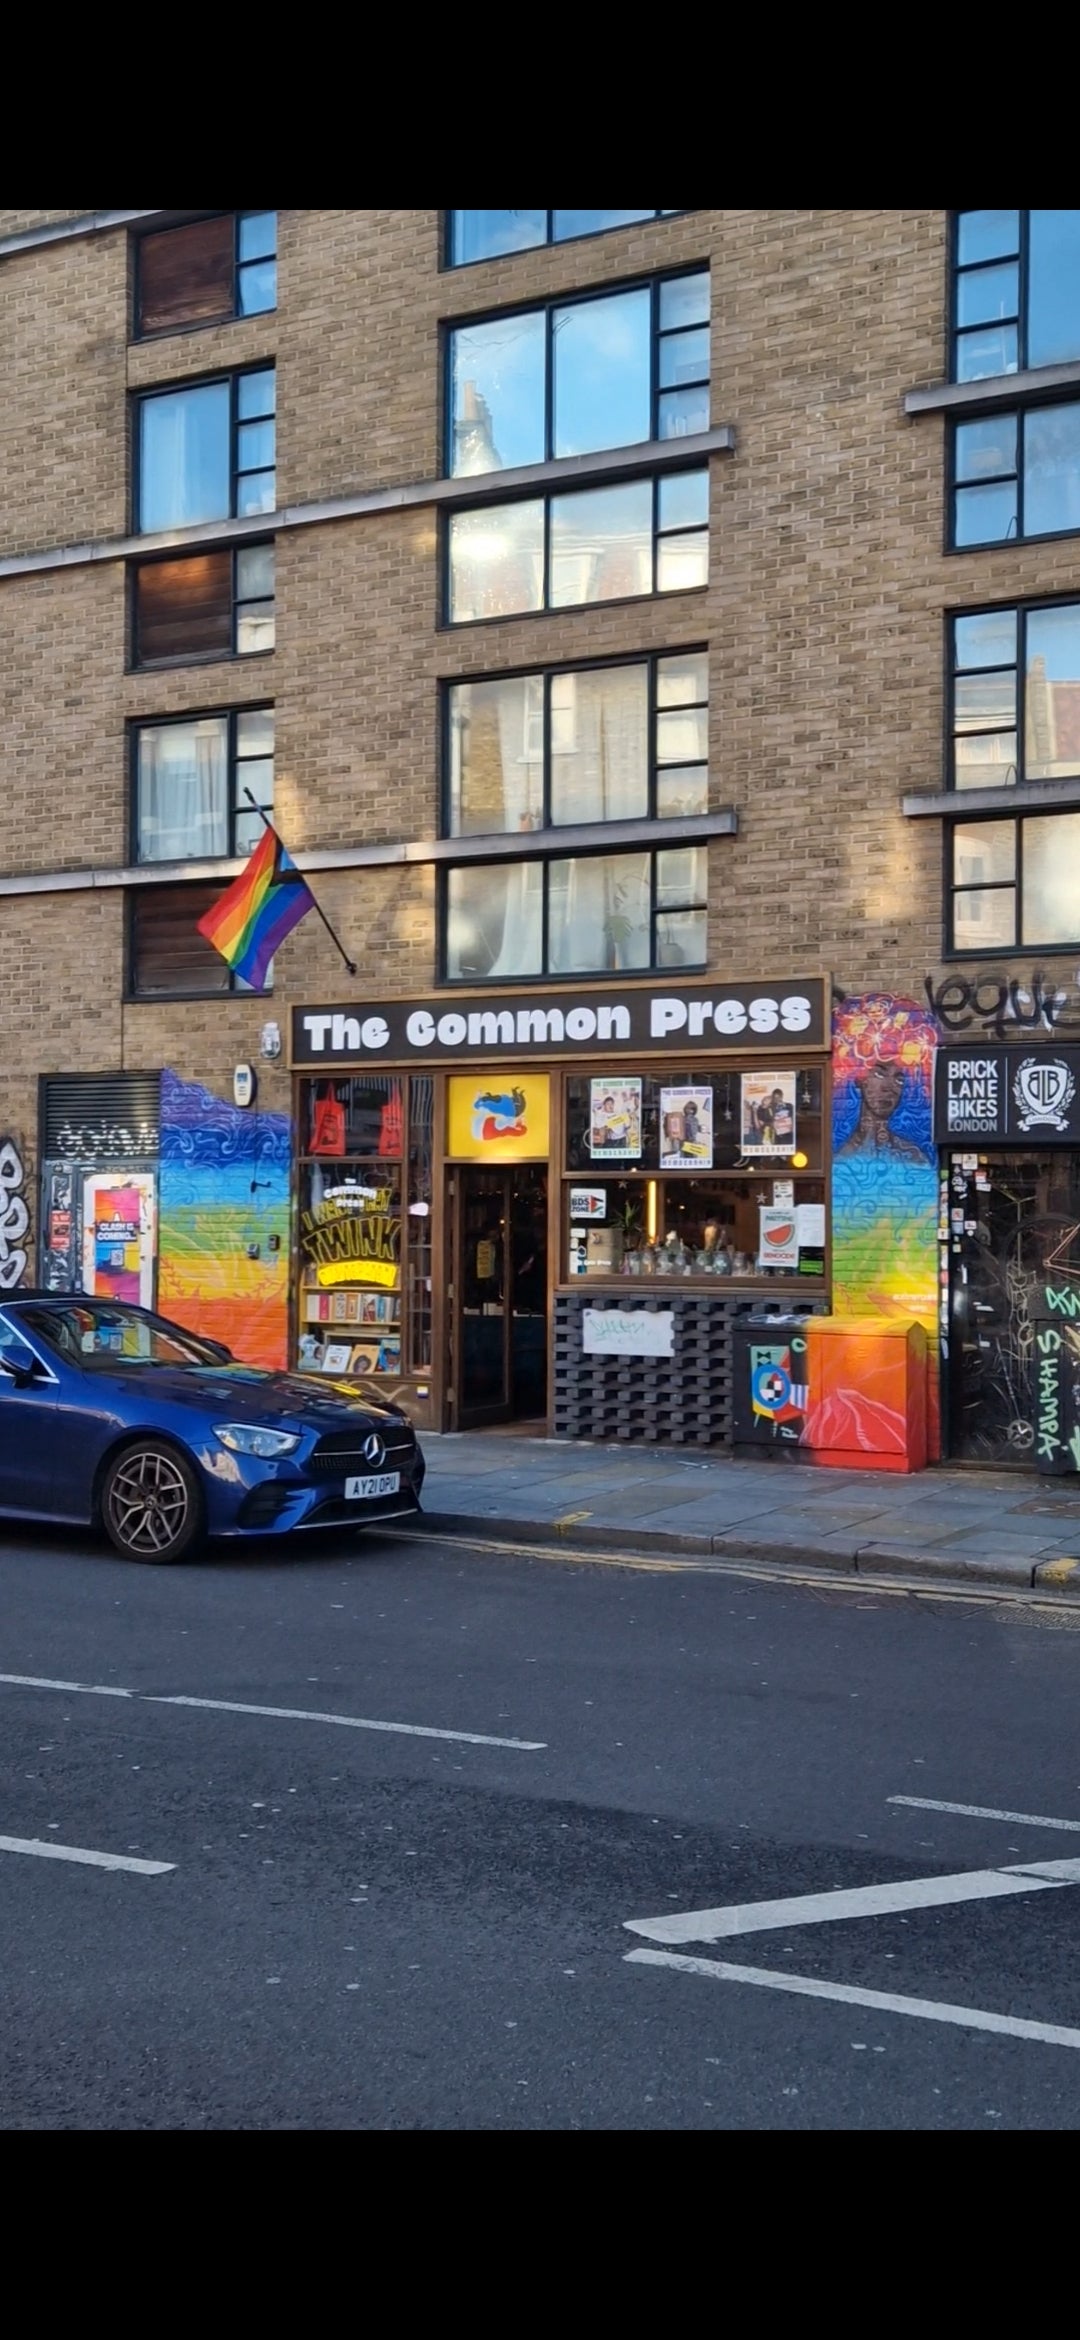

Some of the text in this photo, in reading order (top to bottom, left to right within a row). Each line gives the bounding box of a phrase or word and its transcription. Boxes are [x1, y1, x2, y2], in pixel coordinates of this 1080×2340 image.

[303, 996, 811, 1051] The Common Press
[948, 1060, 998, 1079] BRICK
[948, 1080, 998, 1098] LANE
[948, 1099, 998, 1118] BIKES
[948, 1119, 997, 1132] LONDON
[302, 1215, 402, 1264] TWINK
[352, 1474, 397, 1496] AY21 OPU
